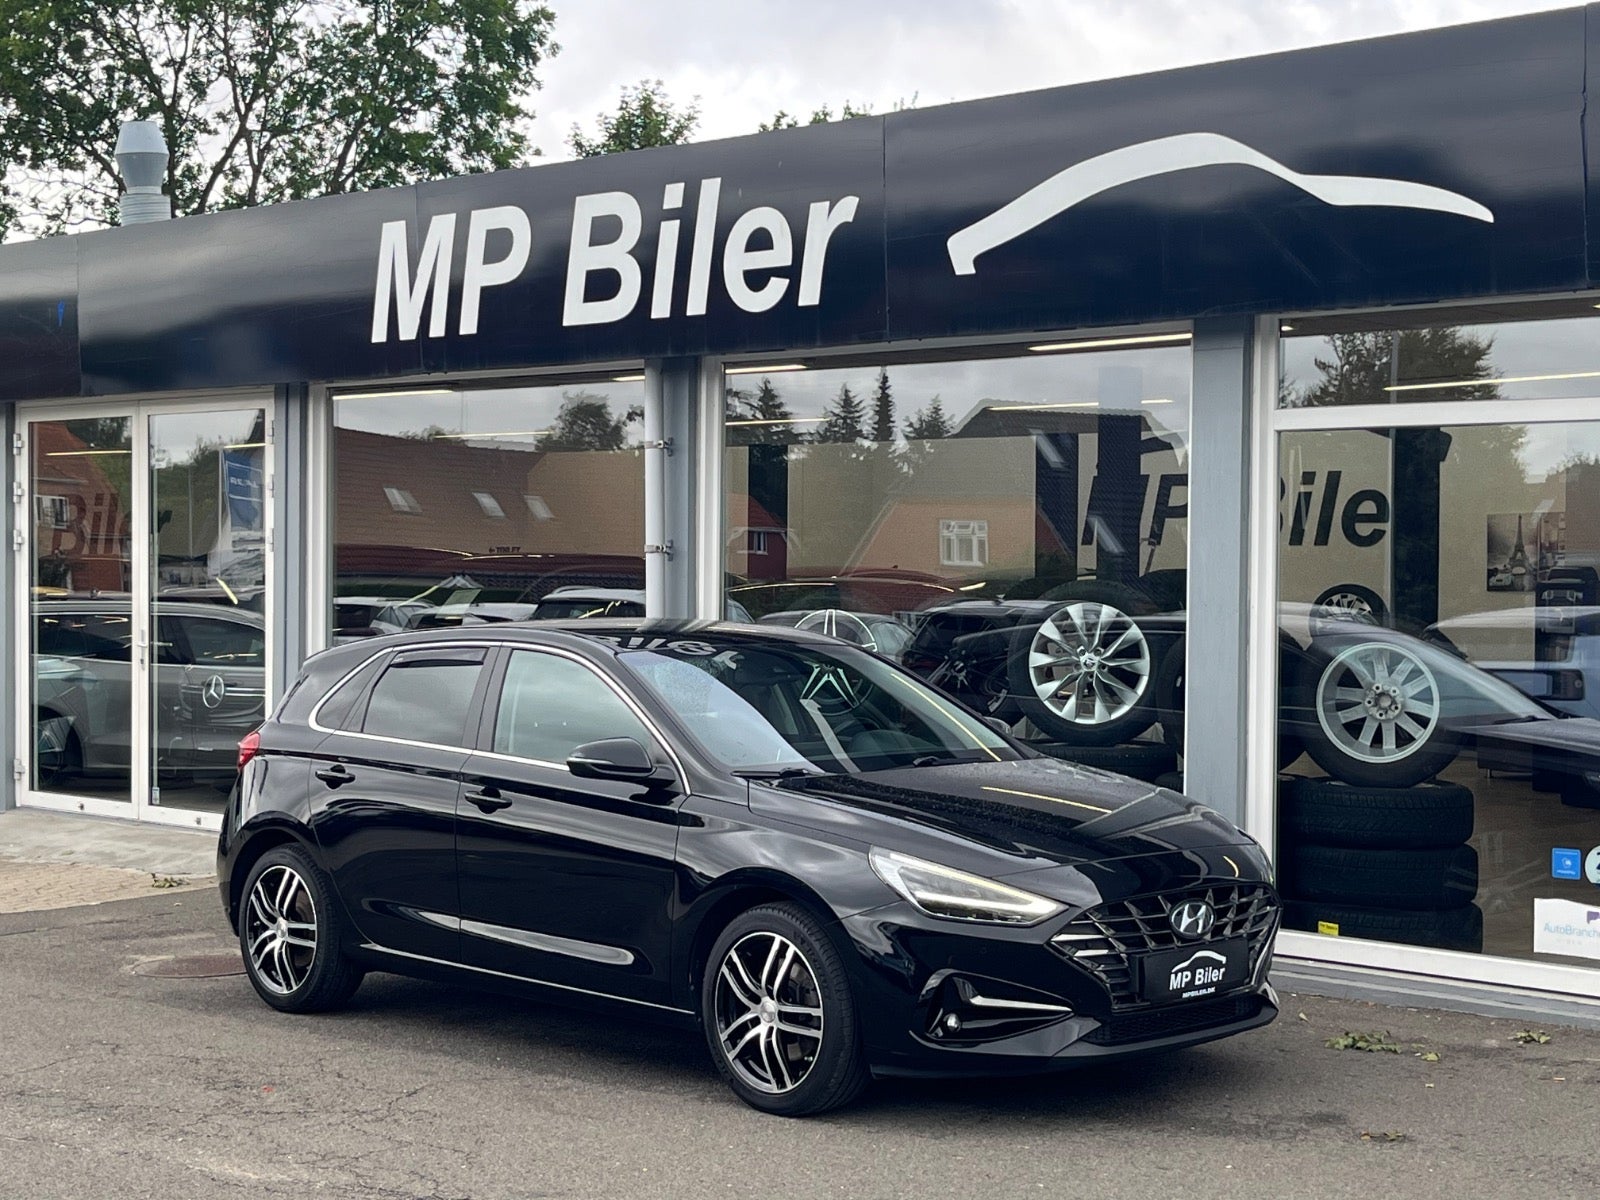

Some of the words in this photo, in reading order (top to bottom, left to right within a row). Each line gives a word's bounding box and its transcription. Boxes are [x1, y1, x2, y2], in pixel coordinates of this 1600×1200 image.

[371, 205, 532, 343] MP
[562, 177, 860, 327] Biler
[1543, 922, 1600, 941] AutoBranch
[1169, 971, 1192, 990] MP
[1194, 966, 1226, 985] Biler
